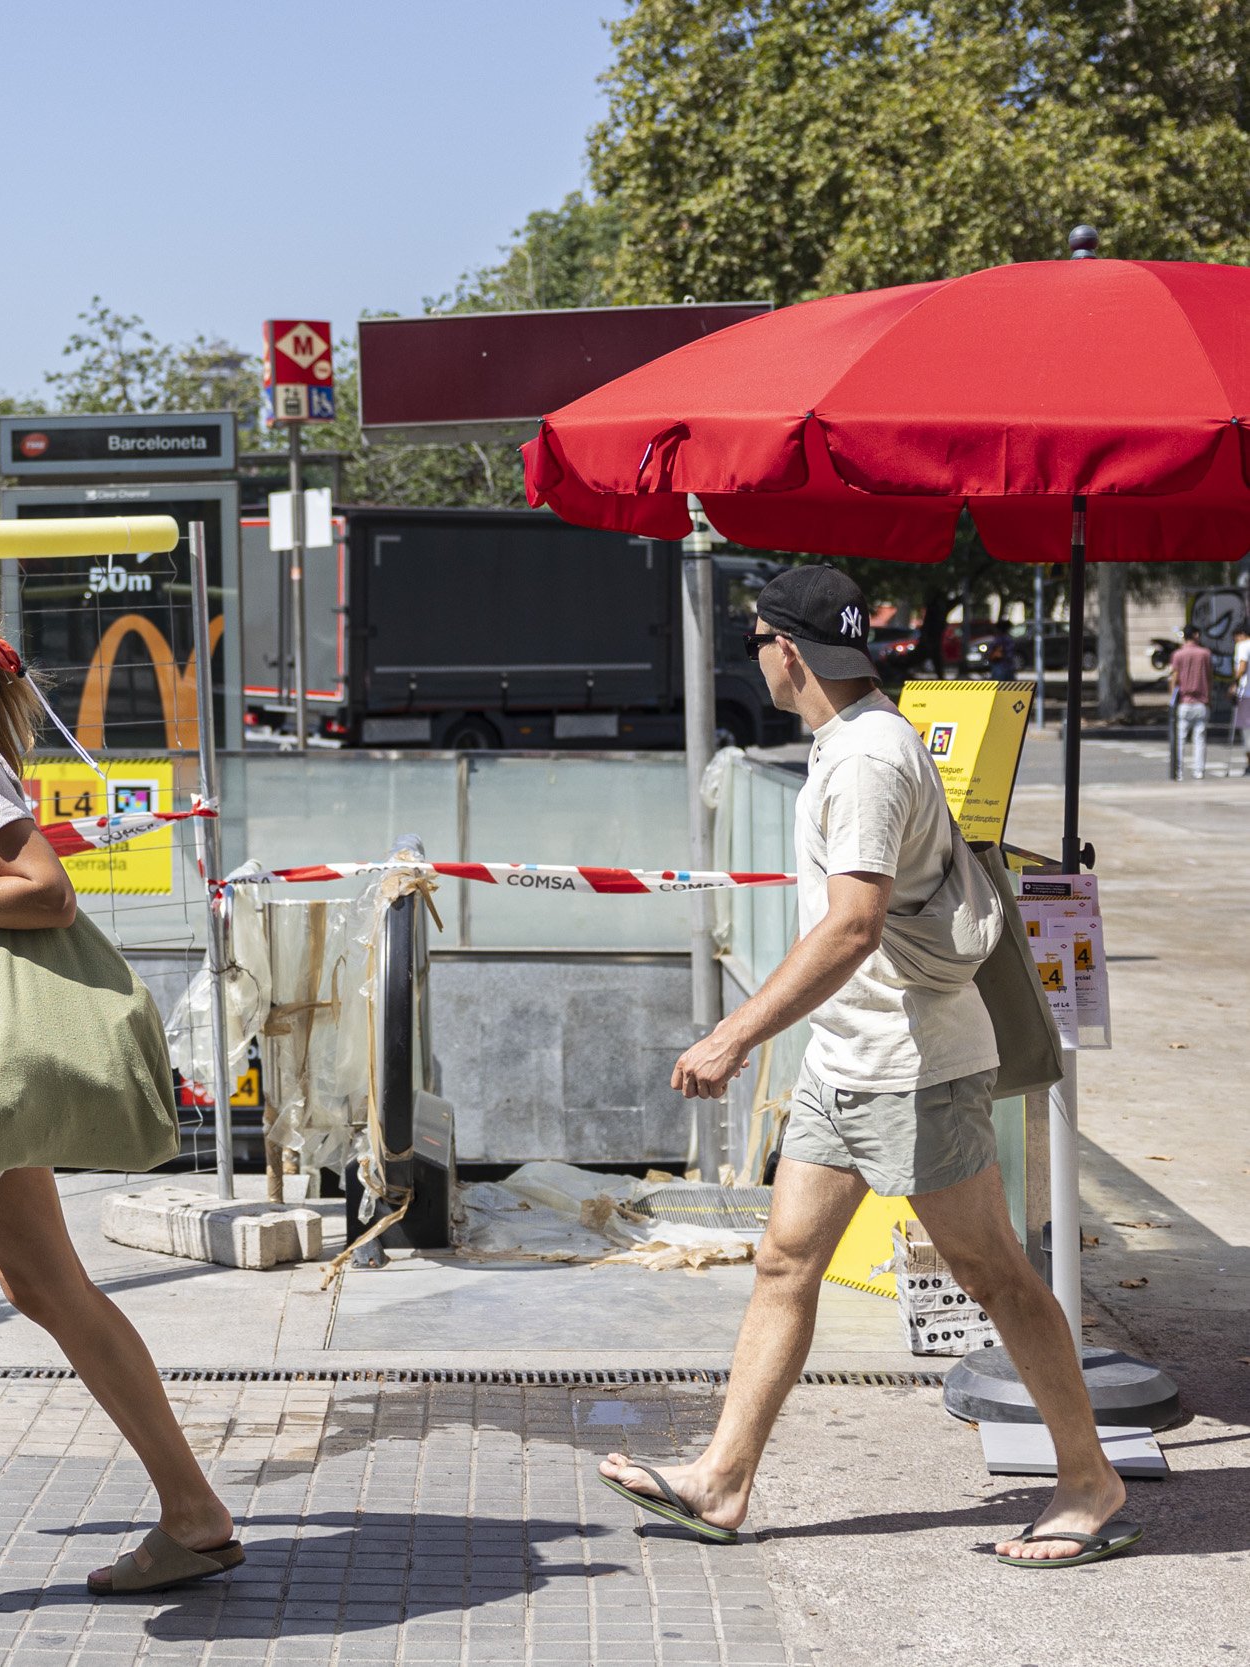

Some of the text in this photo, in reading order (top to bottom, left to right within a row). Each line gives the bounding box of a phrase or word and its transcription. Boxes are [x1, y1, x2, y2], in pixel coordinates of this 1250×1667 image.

[293, 336, 313, 356] M
[107, 434, 208, 451] Barceloneta
[88, 565, 152, 593] 50m
[840, 605, 862, 639] NY
[54, 790, 92, 817] L4
[66, 856, 128, 871] cerrada
[507, 873, 576, 891] COMSA
